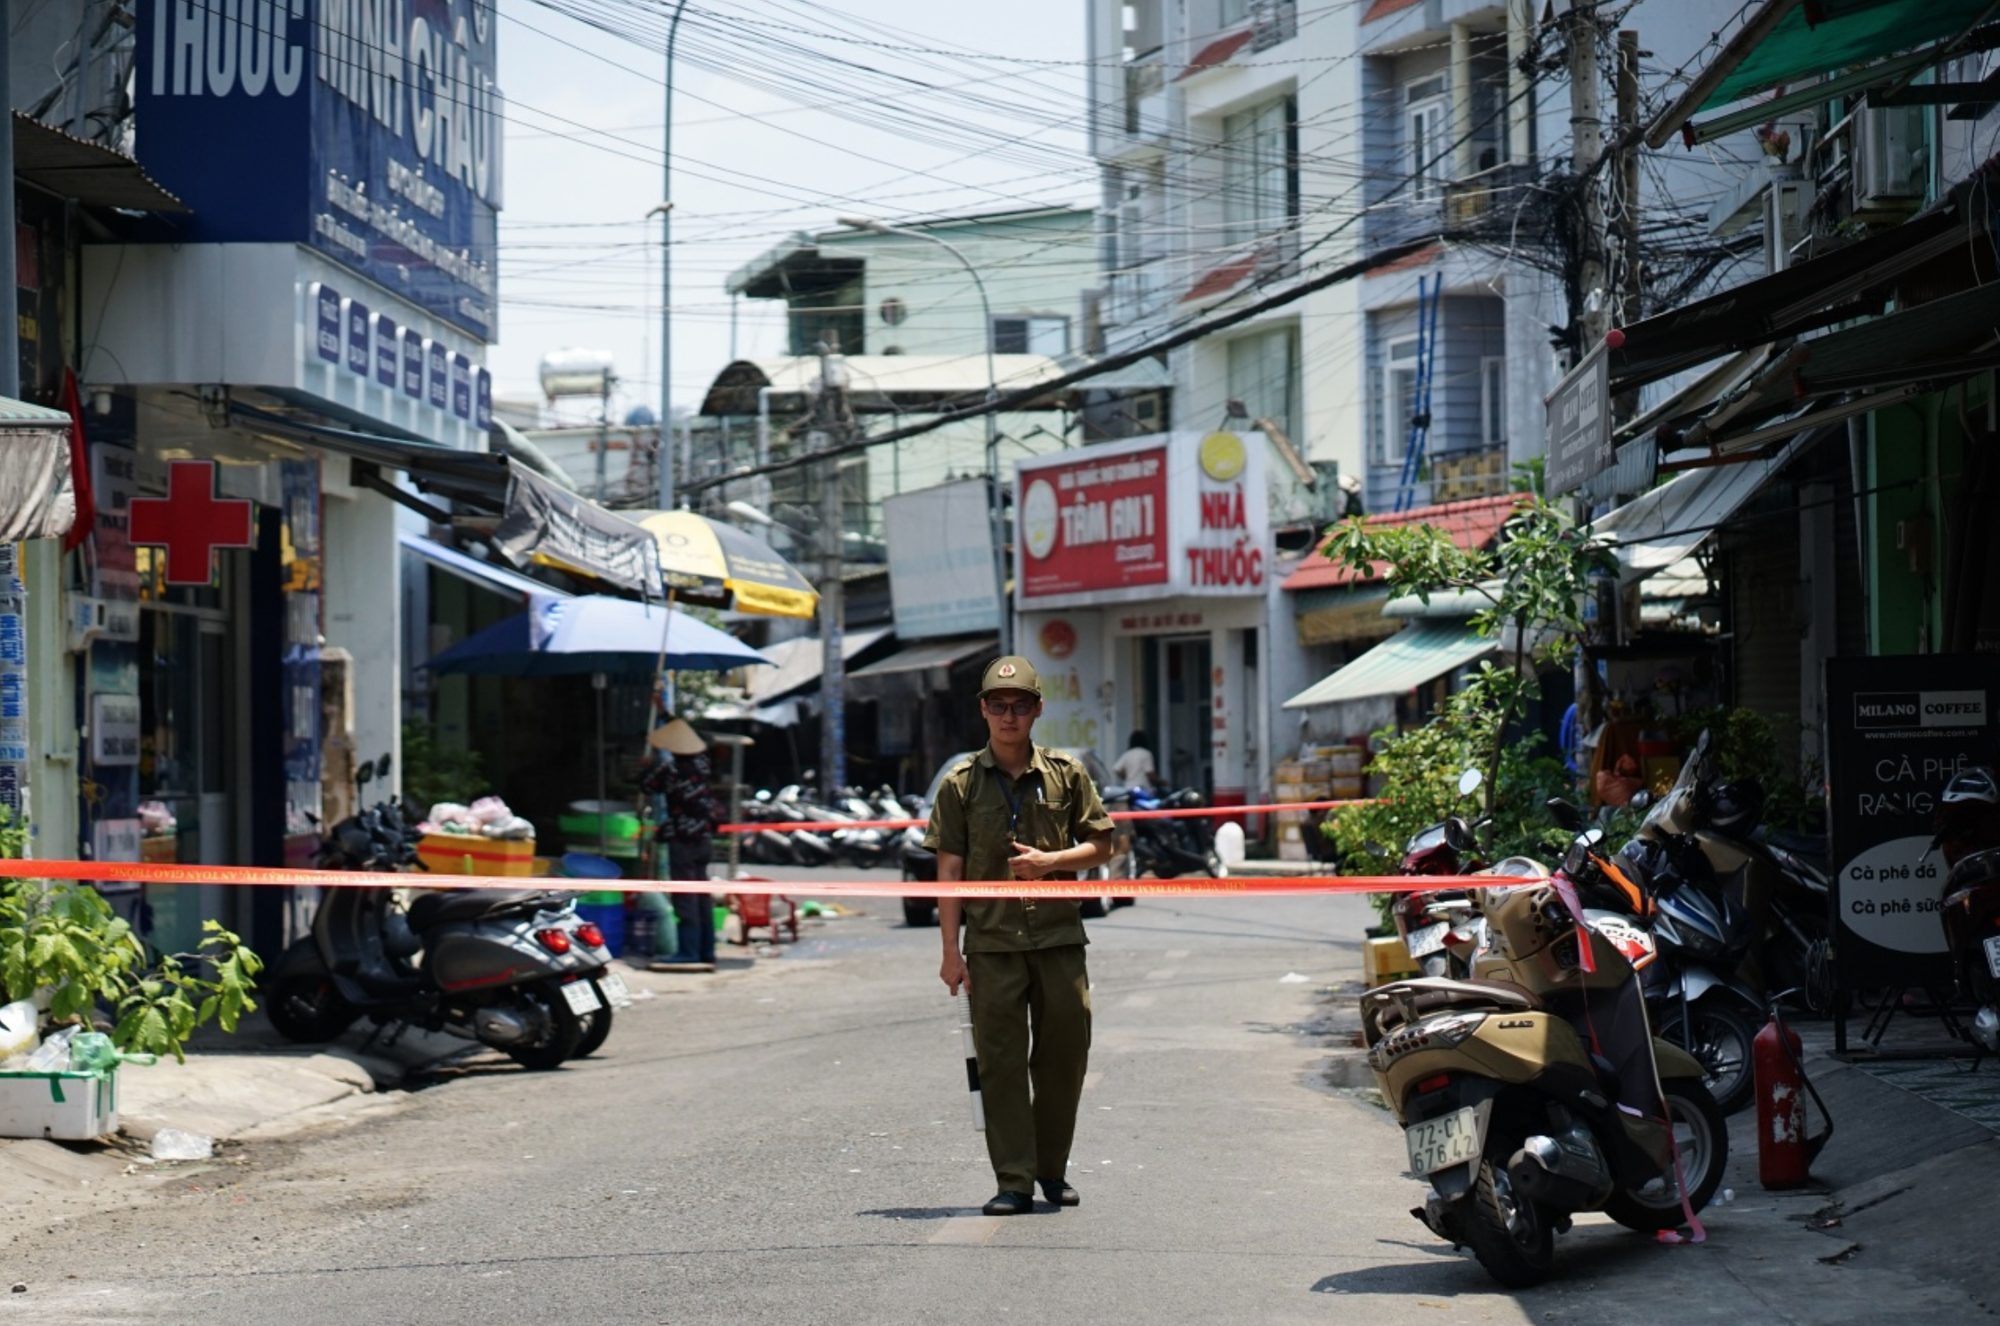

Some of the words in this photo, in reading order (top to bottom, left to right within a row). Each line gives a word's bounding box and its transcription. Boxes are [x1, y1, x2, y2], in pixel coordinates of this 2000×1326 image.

[318, 0, 403, 138] MINH
[410, 16, 489, 200] CHÂU
[1200, 482, 1247, 530] NHÀ
[1061, 491, 1108, 547] TÂM
[1185, 535, 1263, 586] THUỐC
[1858, 704, 1917, 717] MILANO
[1924, 702, 1983, 716] COFFEE
[1875, 753, 1917, 783] CÀ
[154, 868, 184, 879] GIAO
[221, 871, 235, 880] AN
[1850, 865, 1874, 880] Cà
[1879, 864, 1910, 883] phê
[1915, 863, 1937, 879] đá
[954, 885, 995, 895] THÔNG
[999, 885, 1030, 895] GIAO
[1065, 885, 1080, 894] AN
[1851, 899, 1875, 914] Cà
[1880, 898, 1911, 917] phê
[1417, 1113, 1463, 1149] 72-C1
[1413, 1135, 1473, 1173] 676.42
